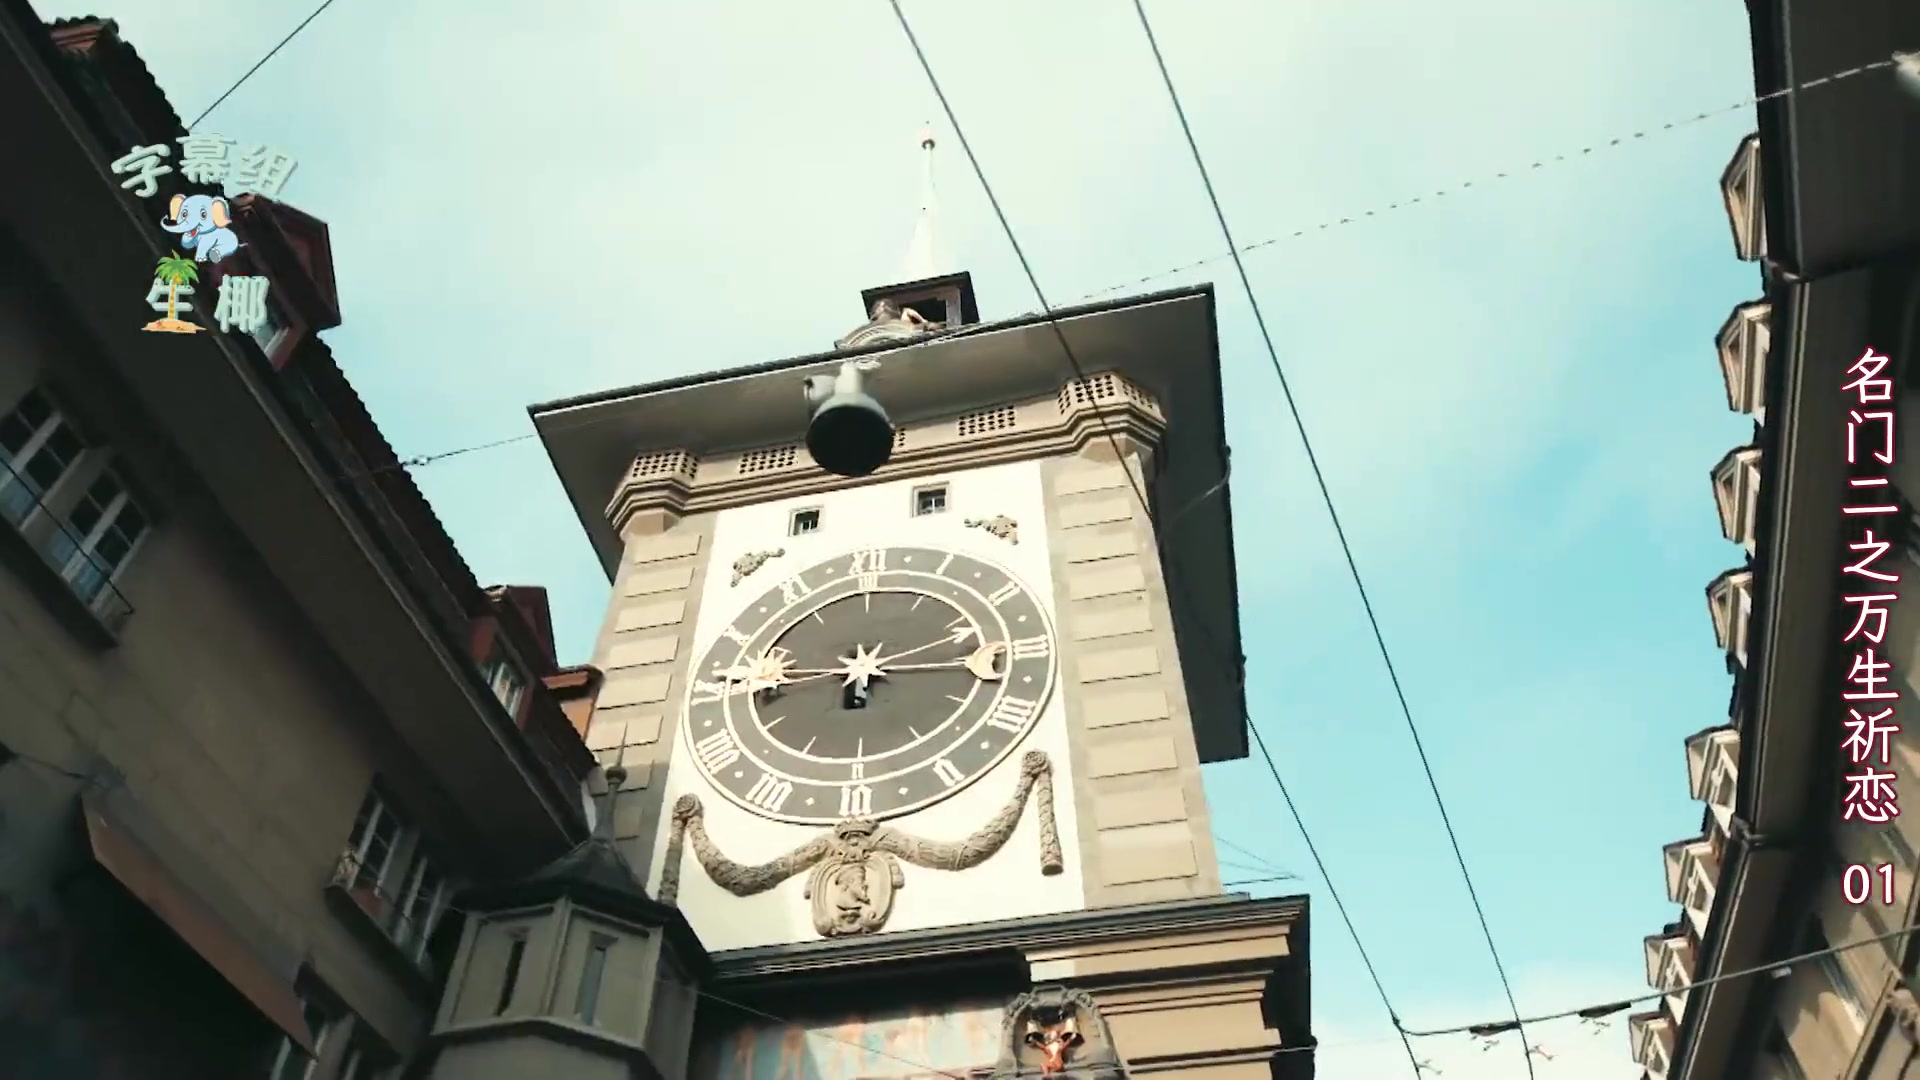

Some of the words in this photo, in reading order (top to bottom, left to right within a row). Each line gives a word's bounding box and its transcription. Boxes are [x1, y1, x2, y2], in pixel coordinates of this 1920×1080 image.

[849, 549, 886, 576] XII
[778, 574, 812, 605] XI
[1012, 634, 1049, 660] III
